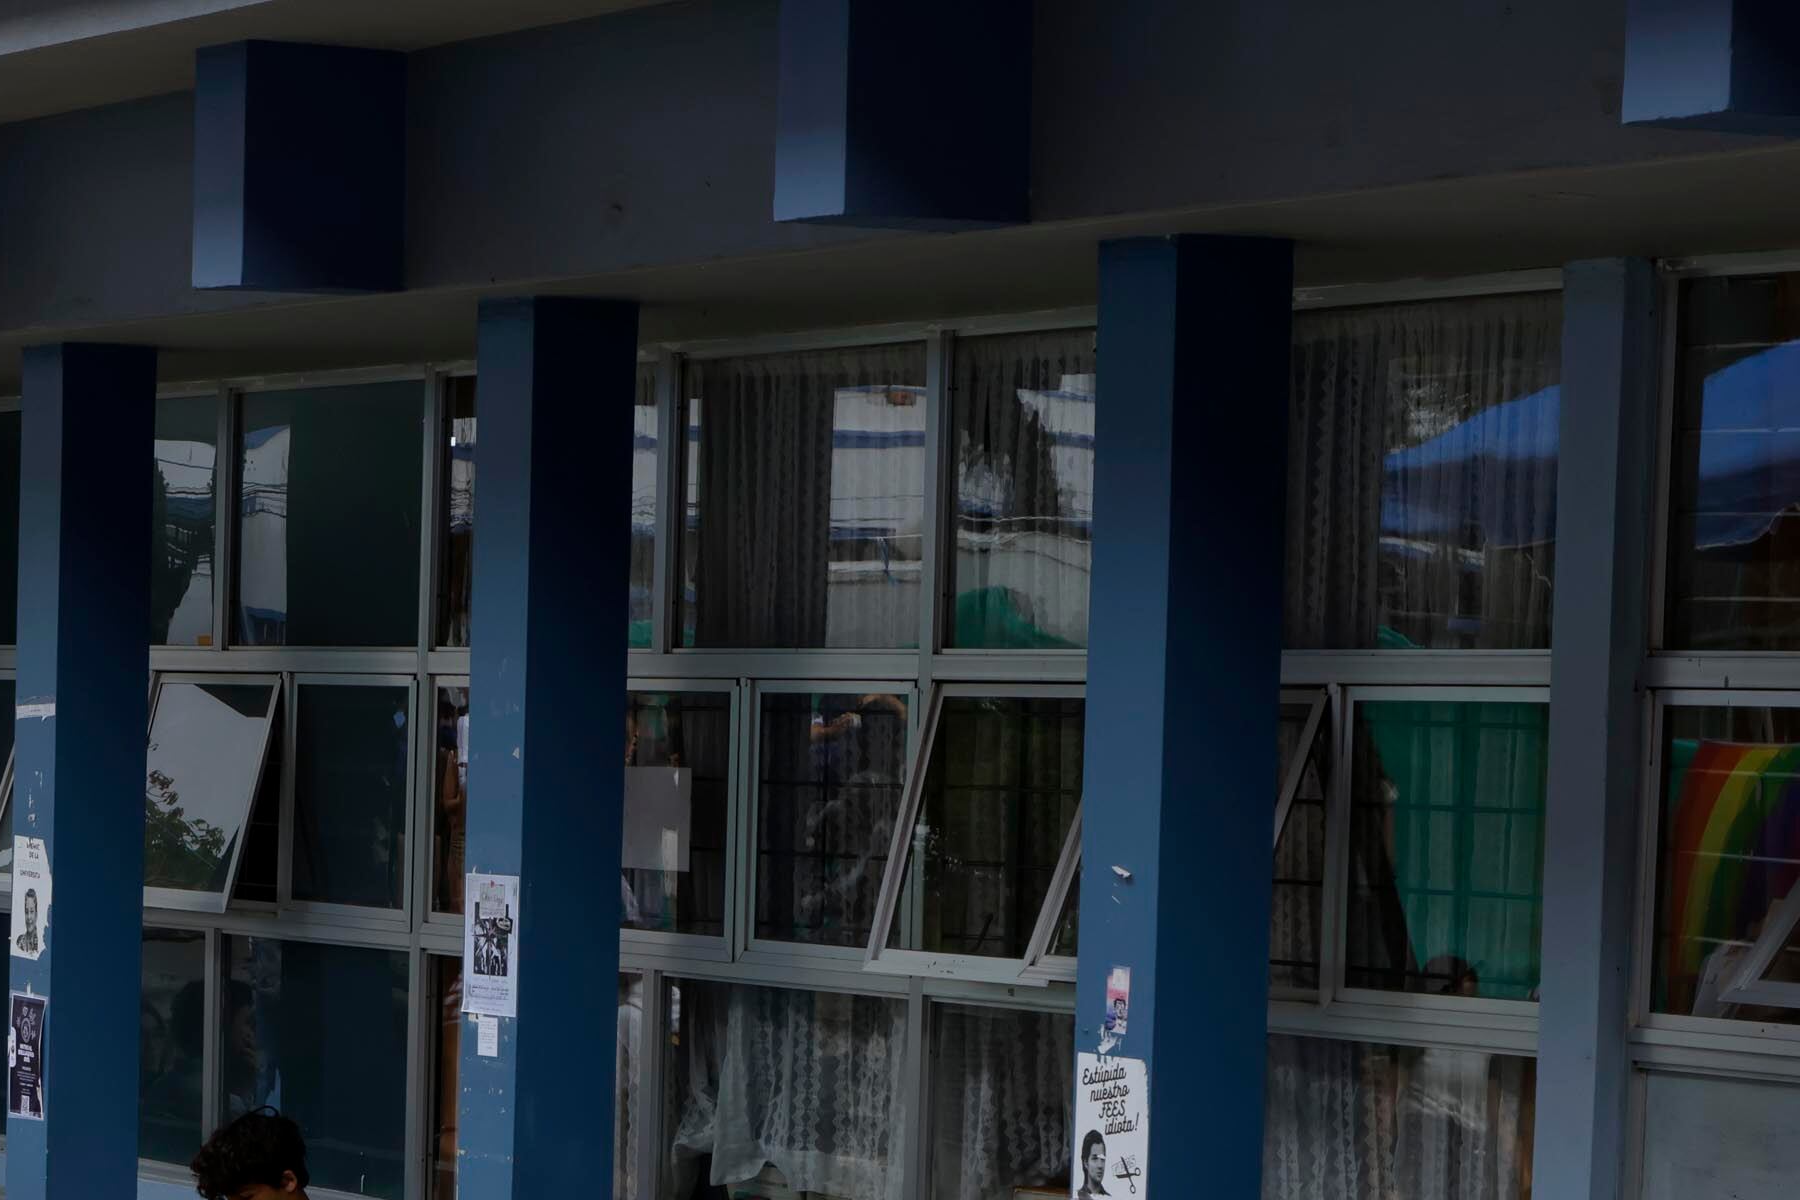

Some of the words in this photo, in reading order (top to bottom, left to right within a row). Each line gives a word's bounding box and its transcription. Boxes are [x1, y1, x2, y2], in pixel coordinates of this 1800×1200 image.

[1082, 1063, 1127, 1087] Estúpida
[1090, 1081, 1130, 1102] nuestro
[1098, 1099, 1126, 1119] FEES
[1105, 1112, 1139, 1136] idiota!
